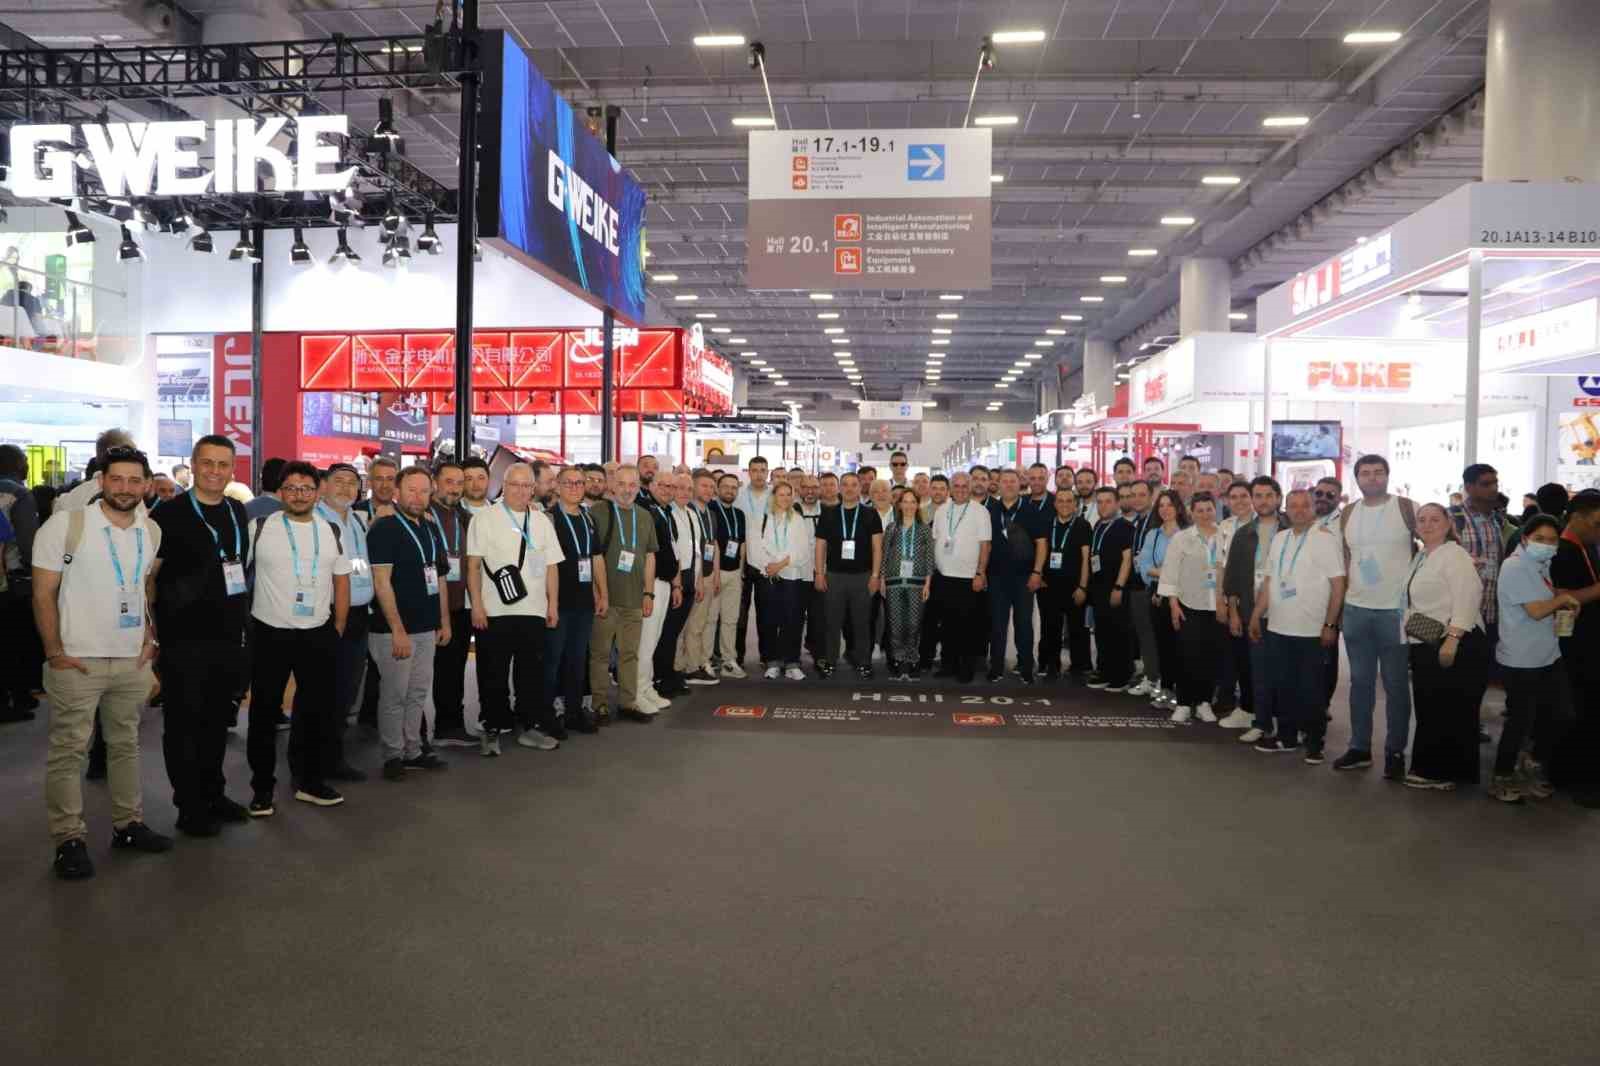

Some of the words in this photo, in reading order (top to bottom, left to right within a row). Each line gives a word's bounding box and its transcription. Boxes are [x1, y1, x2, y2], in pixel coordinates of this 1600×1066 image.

[813, 136, 895, 153] 17.1-19.1
[957, 213, 973, 221] and
[866, 223, 909, 231] Intelligent
[910, 223, 970, 231] Manufacturing
[789, 235, 829, 254] 20.1
[866, 247, 911, 255] Processing
[912, 247, 955, 255] Machinery
[866, 256, 911, 264] Equipment
[852, 692, 944, 703] Hall
[959, 696, 1051, 706] 20.1
